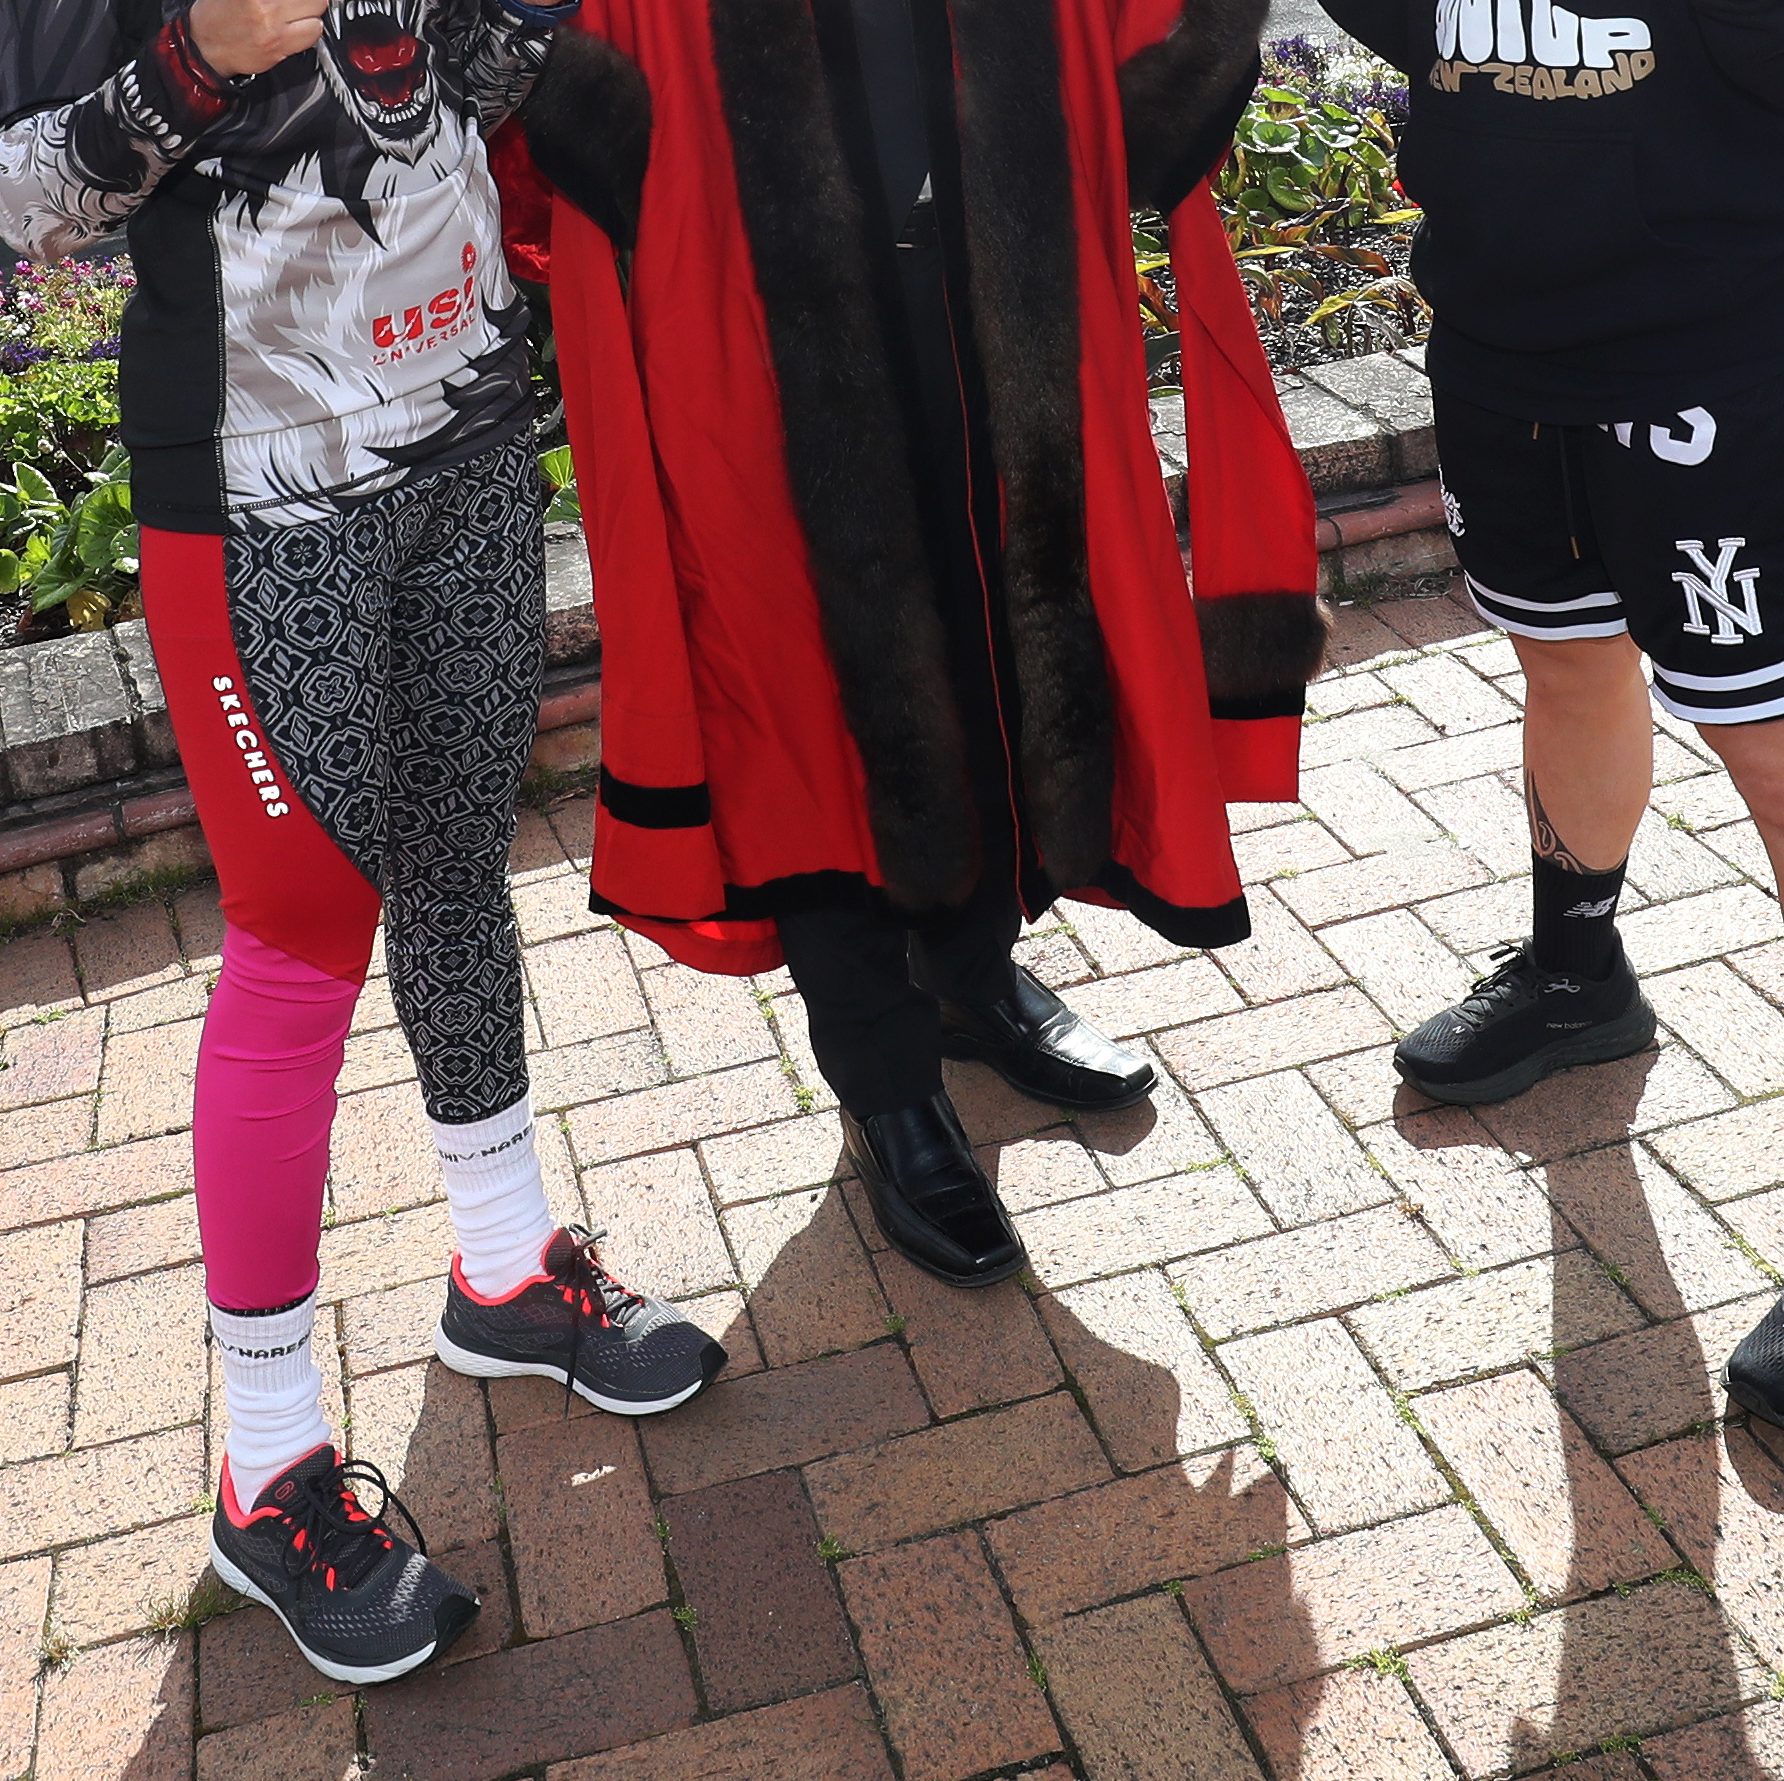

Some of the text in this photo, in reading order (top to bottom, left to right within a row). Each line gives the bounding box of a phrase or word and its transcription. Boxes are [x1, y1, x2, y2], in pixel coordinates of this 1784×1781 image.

[1478, 50, 1656, 101] ZEALAND
[372, 313, 475, 366] UNIVERSAL
[213, 675, 291, 818] SKECHERS
